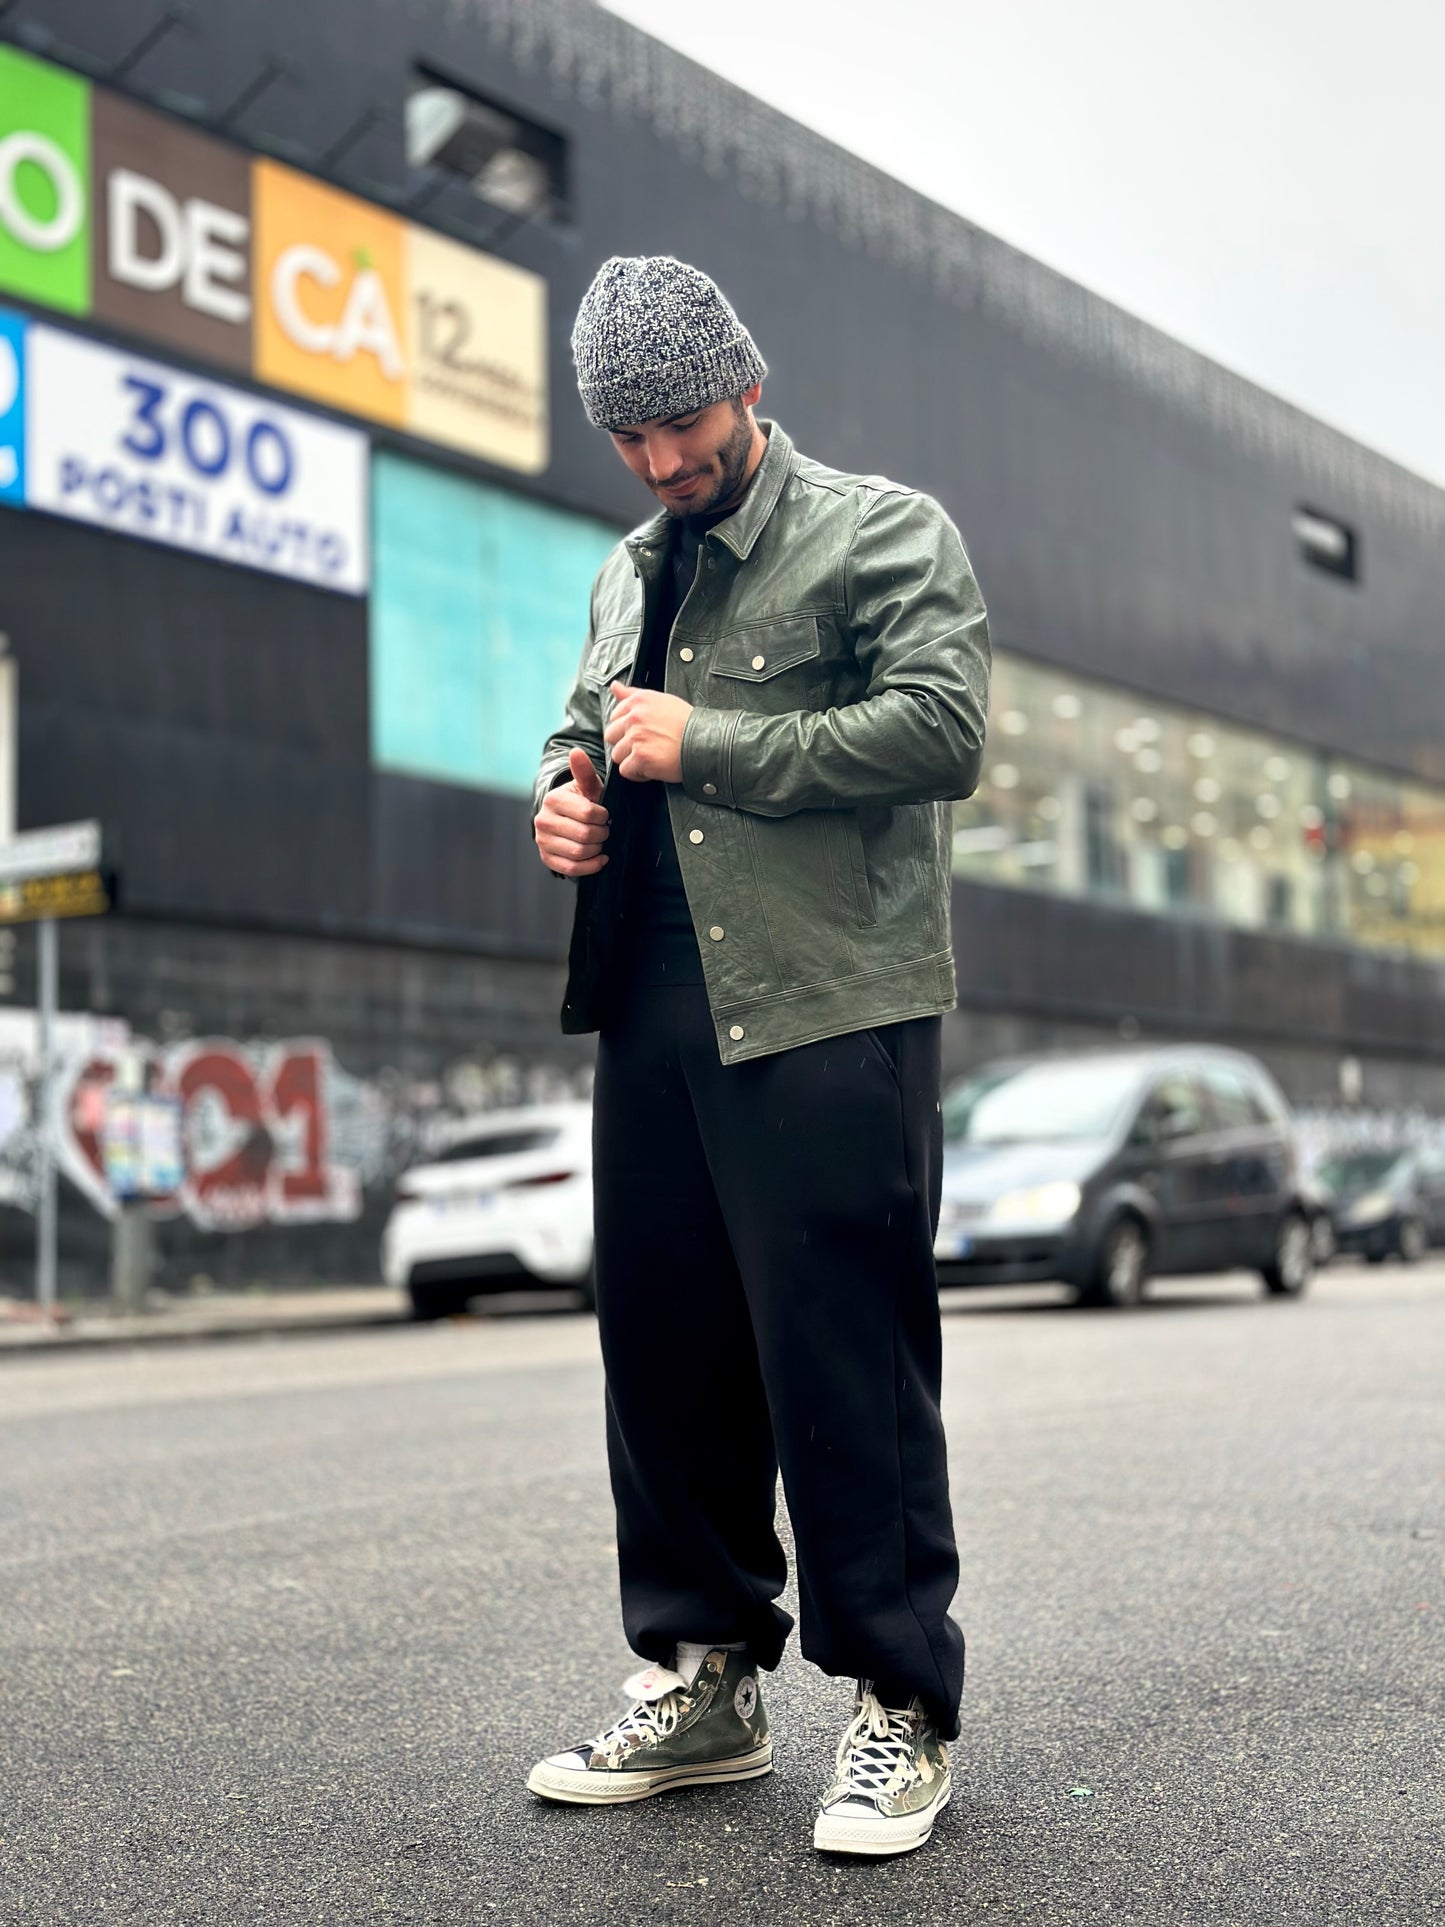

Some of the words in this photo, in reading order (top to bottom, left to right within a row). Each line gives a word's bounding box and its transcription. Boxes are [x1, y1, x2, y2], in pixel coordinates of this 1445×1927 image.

[108, 166, 251, 323] DE
[416, 288, 474, 374] 12
[121, 372, 296, 498] 300
[59, 455, 208, 537] POSTI
[221, 505, 351, 575] AUTO
